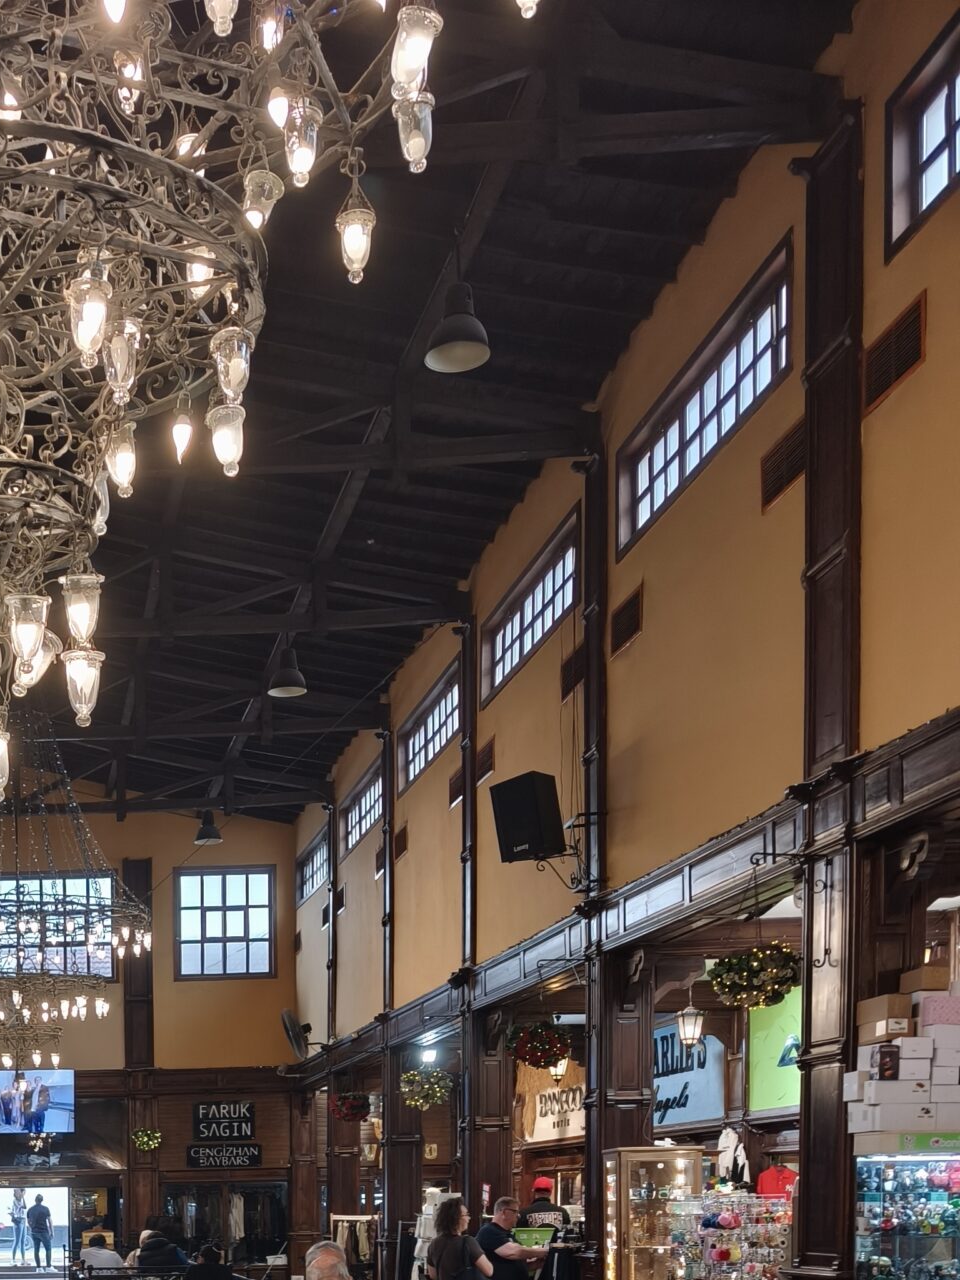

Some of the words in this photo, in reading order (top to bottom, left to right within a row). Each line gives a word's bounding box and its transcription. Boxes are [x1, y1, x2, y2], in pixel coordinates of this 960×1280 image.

[199, 1103, 250, 1118] FARUK
[199, 1122, 251, 1137] SAGIN
[190, 1144, 259, 1157] CENGİZHAN
[199, 1156, 249, 1167] BAYBARS
